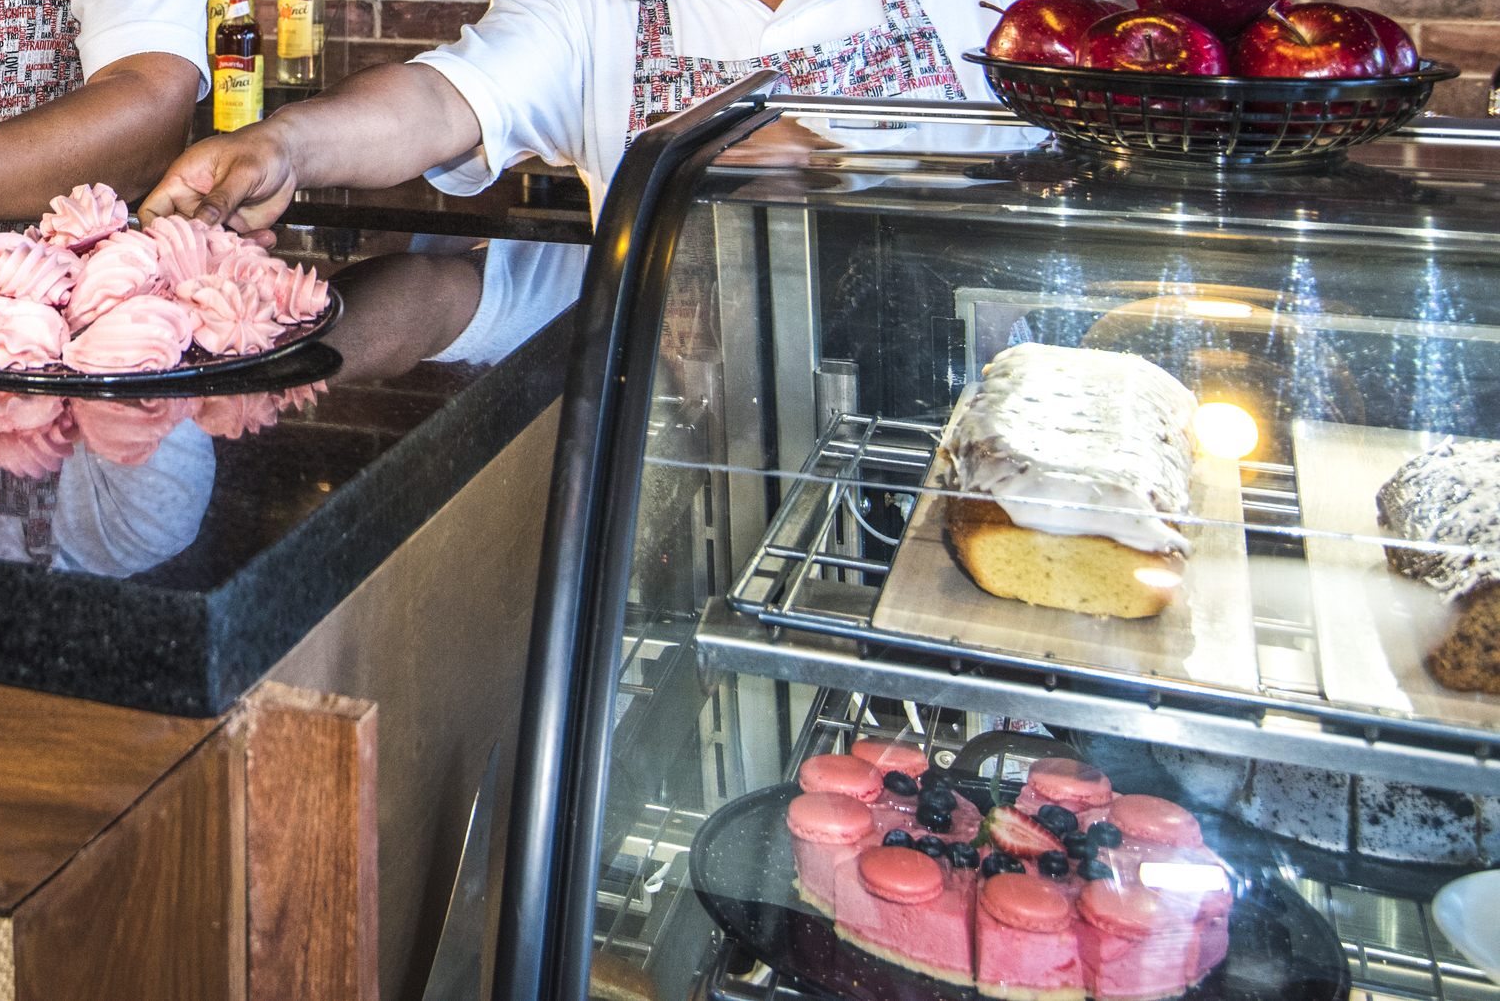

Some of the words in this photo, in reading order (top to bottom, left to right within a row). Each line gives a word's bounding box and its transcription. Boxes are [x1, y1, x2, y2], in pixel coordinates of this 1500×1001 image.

[5, 6, 36, 20] COFFEE
[25, 40, 67, 51] TRADITIONAL
[875, 44, 905, 63] COFFEE
[5, 50, 18, 76] LOVE
[26, 62, 54, 71] MACCHIATO
[920, 65, 937, 75] DARK
[844, 81, 875, 95] CLASSIC
[906, 74, 957, 91] TRADITIONAL
[867, 85, 884, 98] CUP
[1, 95, 30, 108] COFFEE
